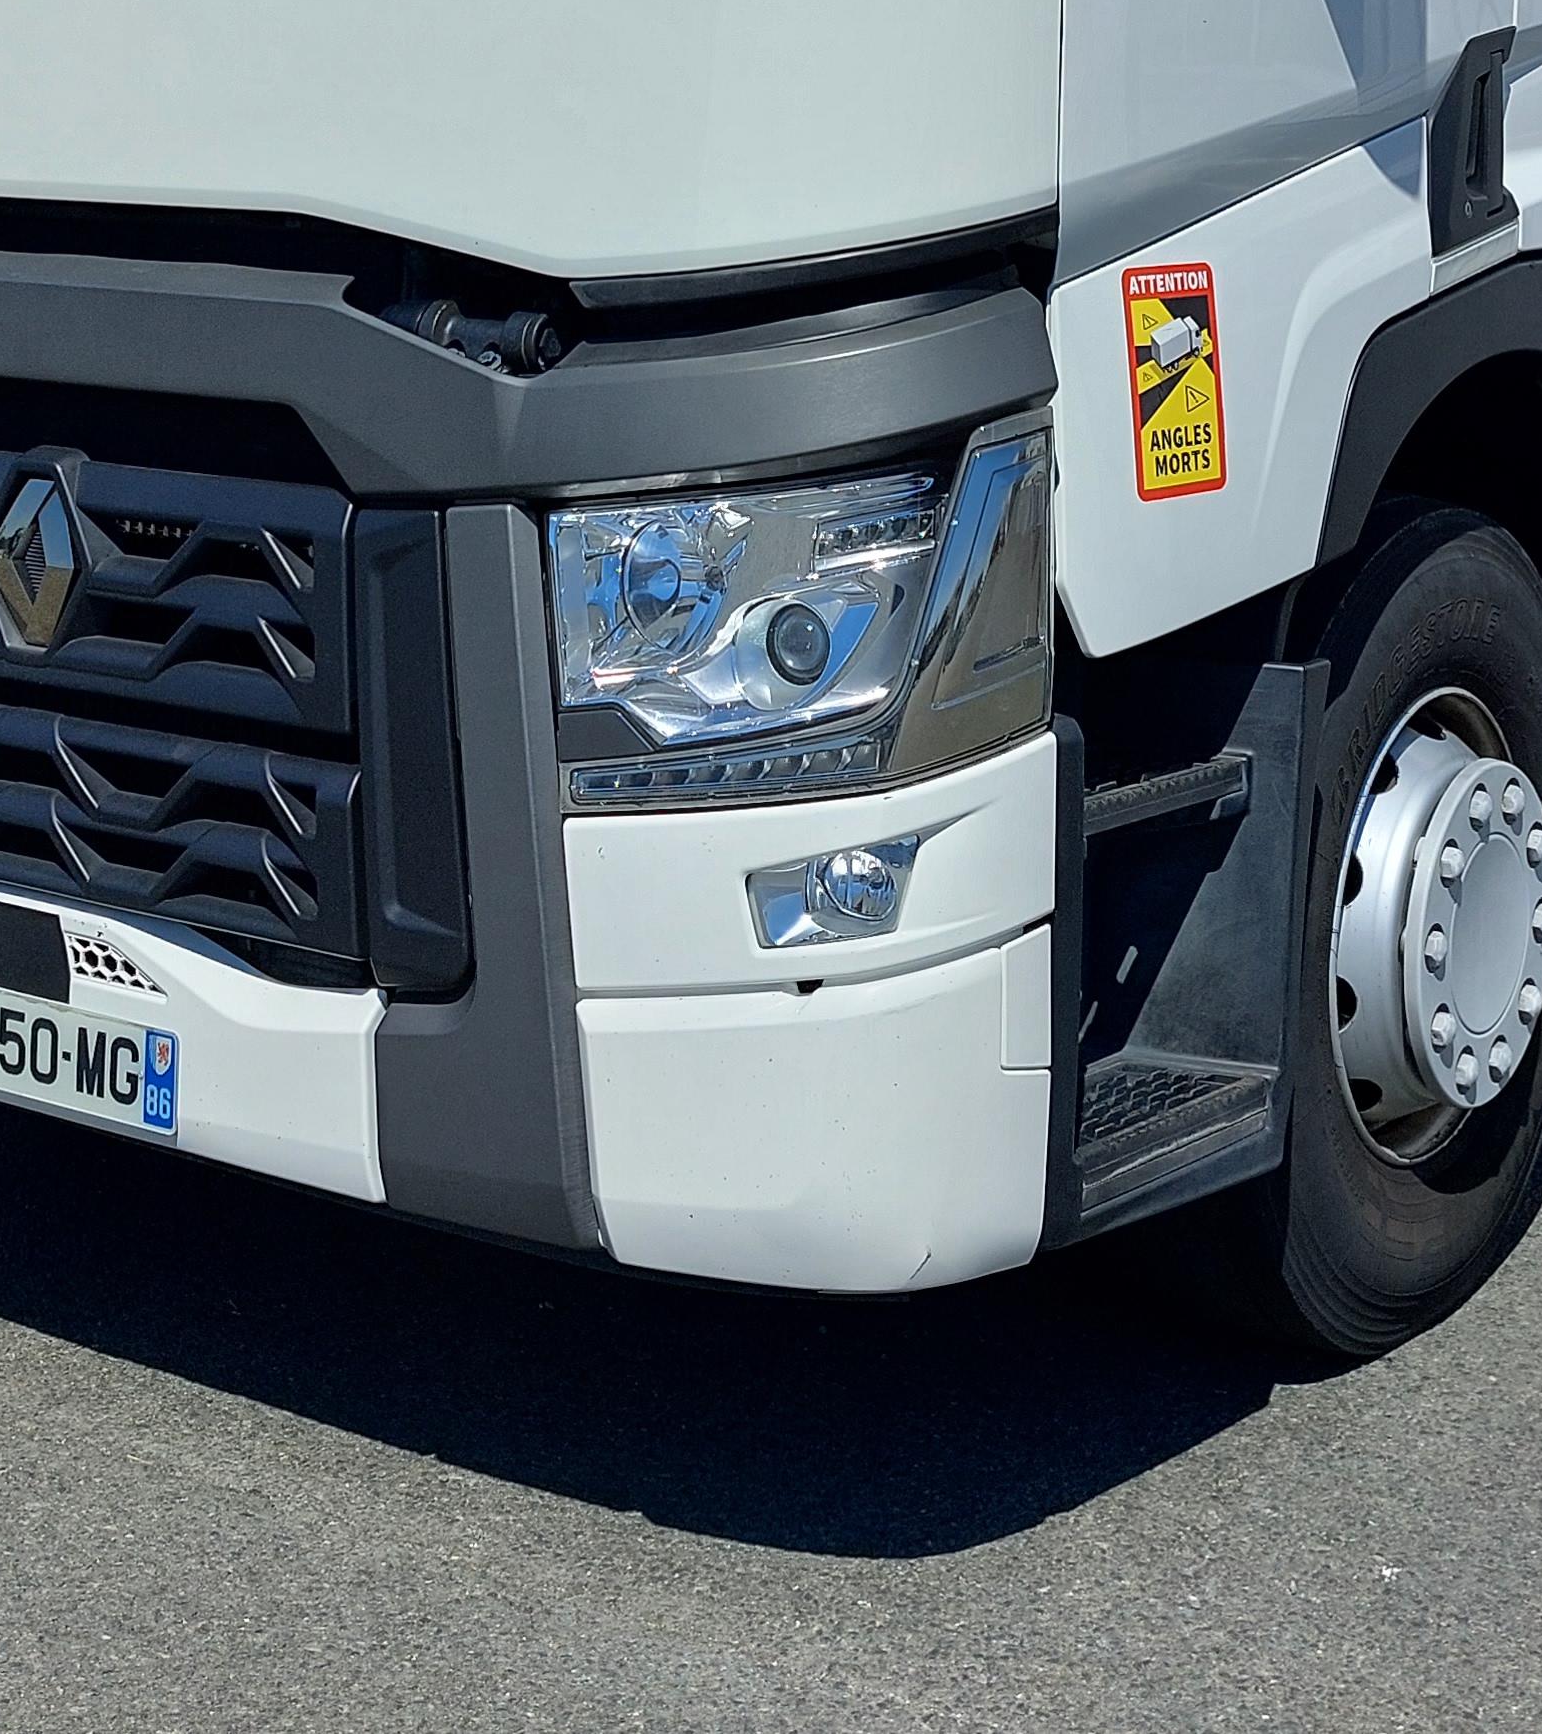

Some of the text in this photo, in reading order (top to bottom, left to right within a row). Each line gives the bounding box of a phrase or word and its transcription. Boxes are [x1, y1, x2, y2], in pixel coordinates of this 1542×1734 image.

[1129, 271, 1209, 295] ATTENTION
[1150, 423, 1212, 452] ANGLES
[1155, 448, 1211, 478] MORTS
[146, 1084, 171, 1120] 86
